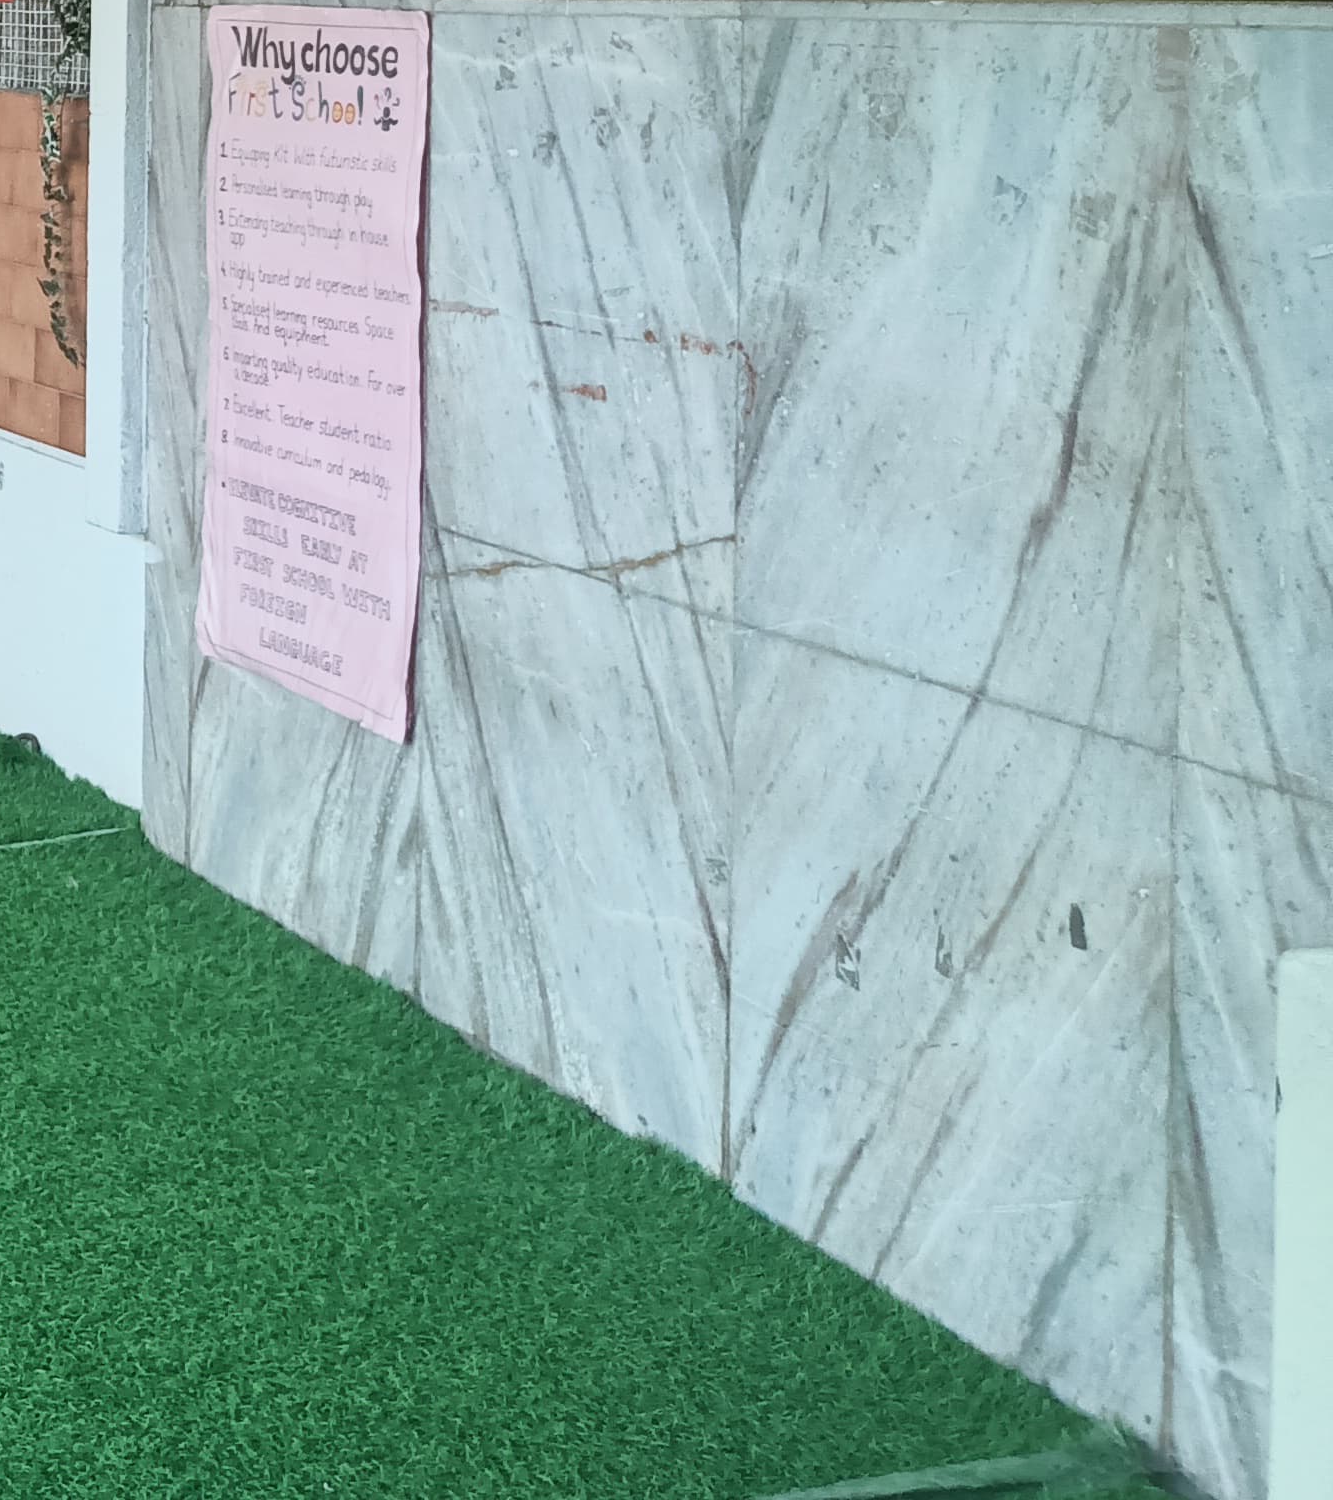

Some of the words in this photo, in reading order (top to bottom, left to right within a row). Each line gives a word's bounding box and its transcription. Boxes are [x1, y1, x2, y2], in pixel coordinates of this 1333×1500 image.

[231, 25, 296, 85] Why
[301, 28, 399, 79] choose
[314, 184, 350, 213] through
[229, 258, 255, 292] Highly
[258, 261, 290, 286] trained
[277, 403, 315, 431] Teacher
[319, 414, 361, 445] student
[282, 563, 336, 601] SCHOOL
[259, 626, 344, 678] LANGUAGE
